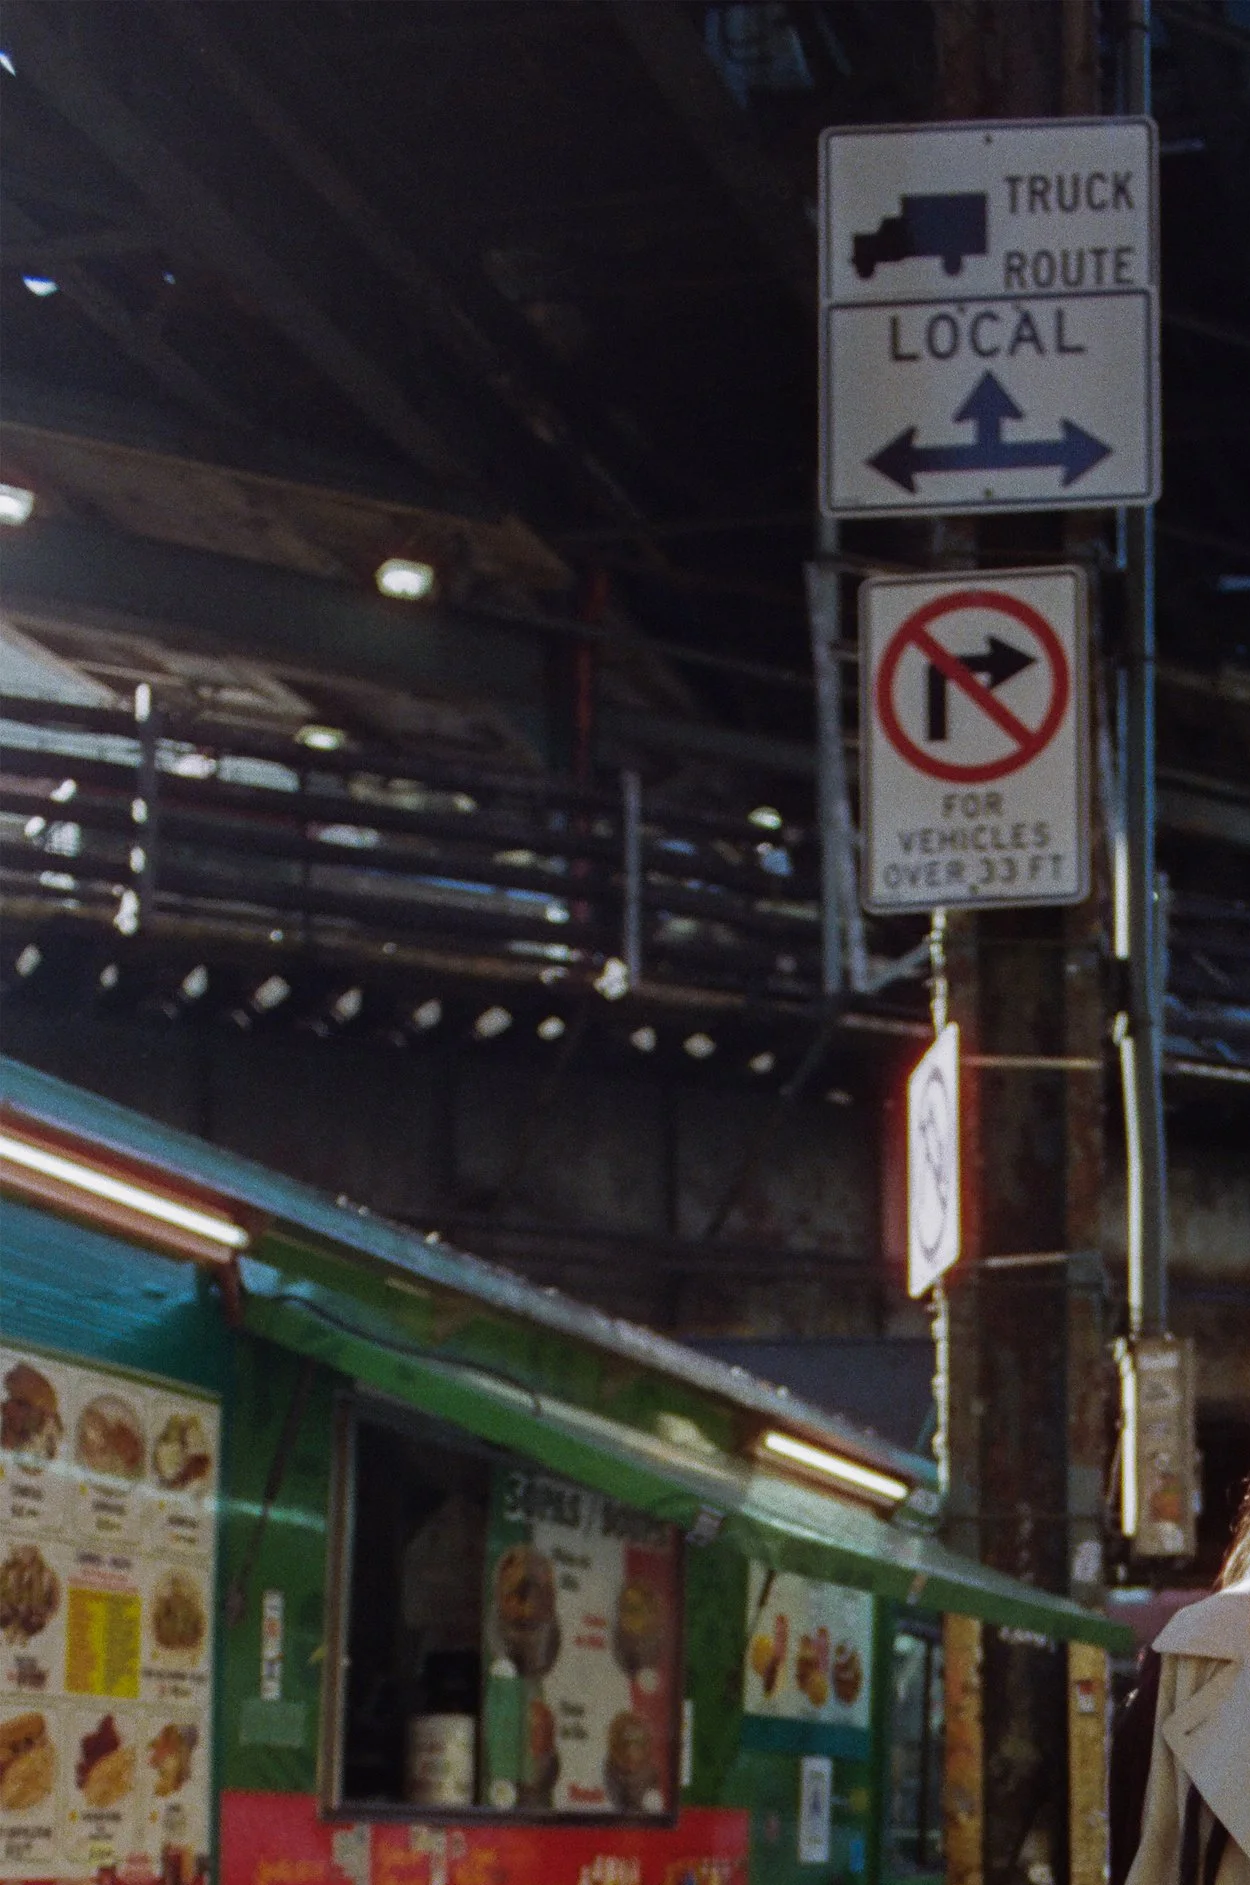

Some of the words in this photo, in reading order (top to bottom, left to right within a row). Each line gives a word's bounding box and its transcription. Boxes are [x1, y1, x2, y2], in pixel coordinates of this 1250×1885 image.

[1003, 170, 1135, 214] TRUCK
[1003, 246, 1136, 289] ROUTE
[889, 309, 1088, 362] LOCAL
[942, 792, 1006, 820] FOR
[898, 821, 1051, 854] VEHICLES
[883, 860, 963, 890] OVER
[980, 857, 1018, 885] 33
[1030, 854, 1064, 881] FT
